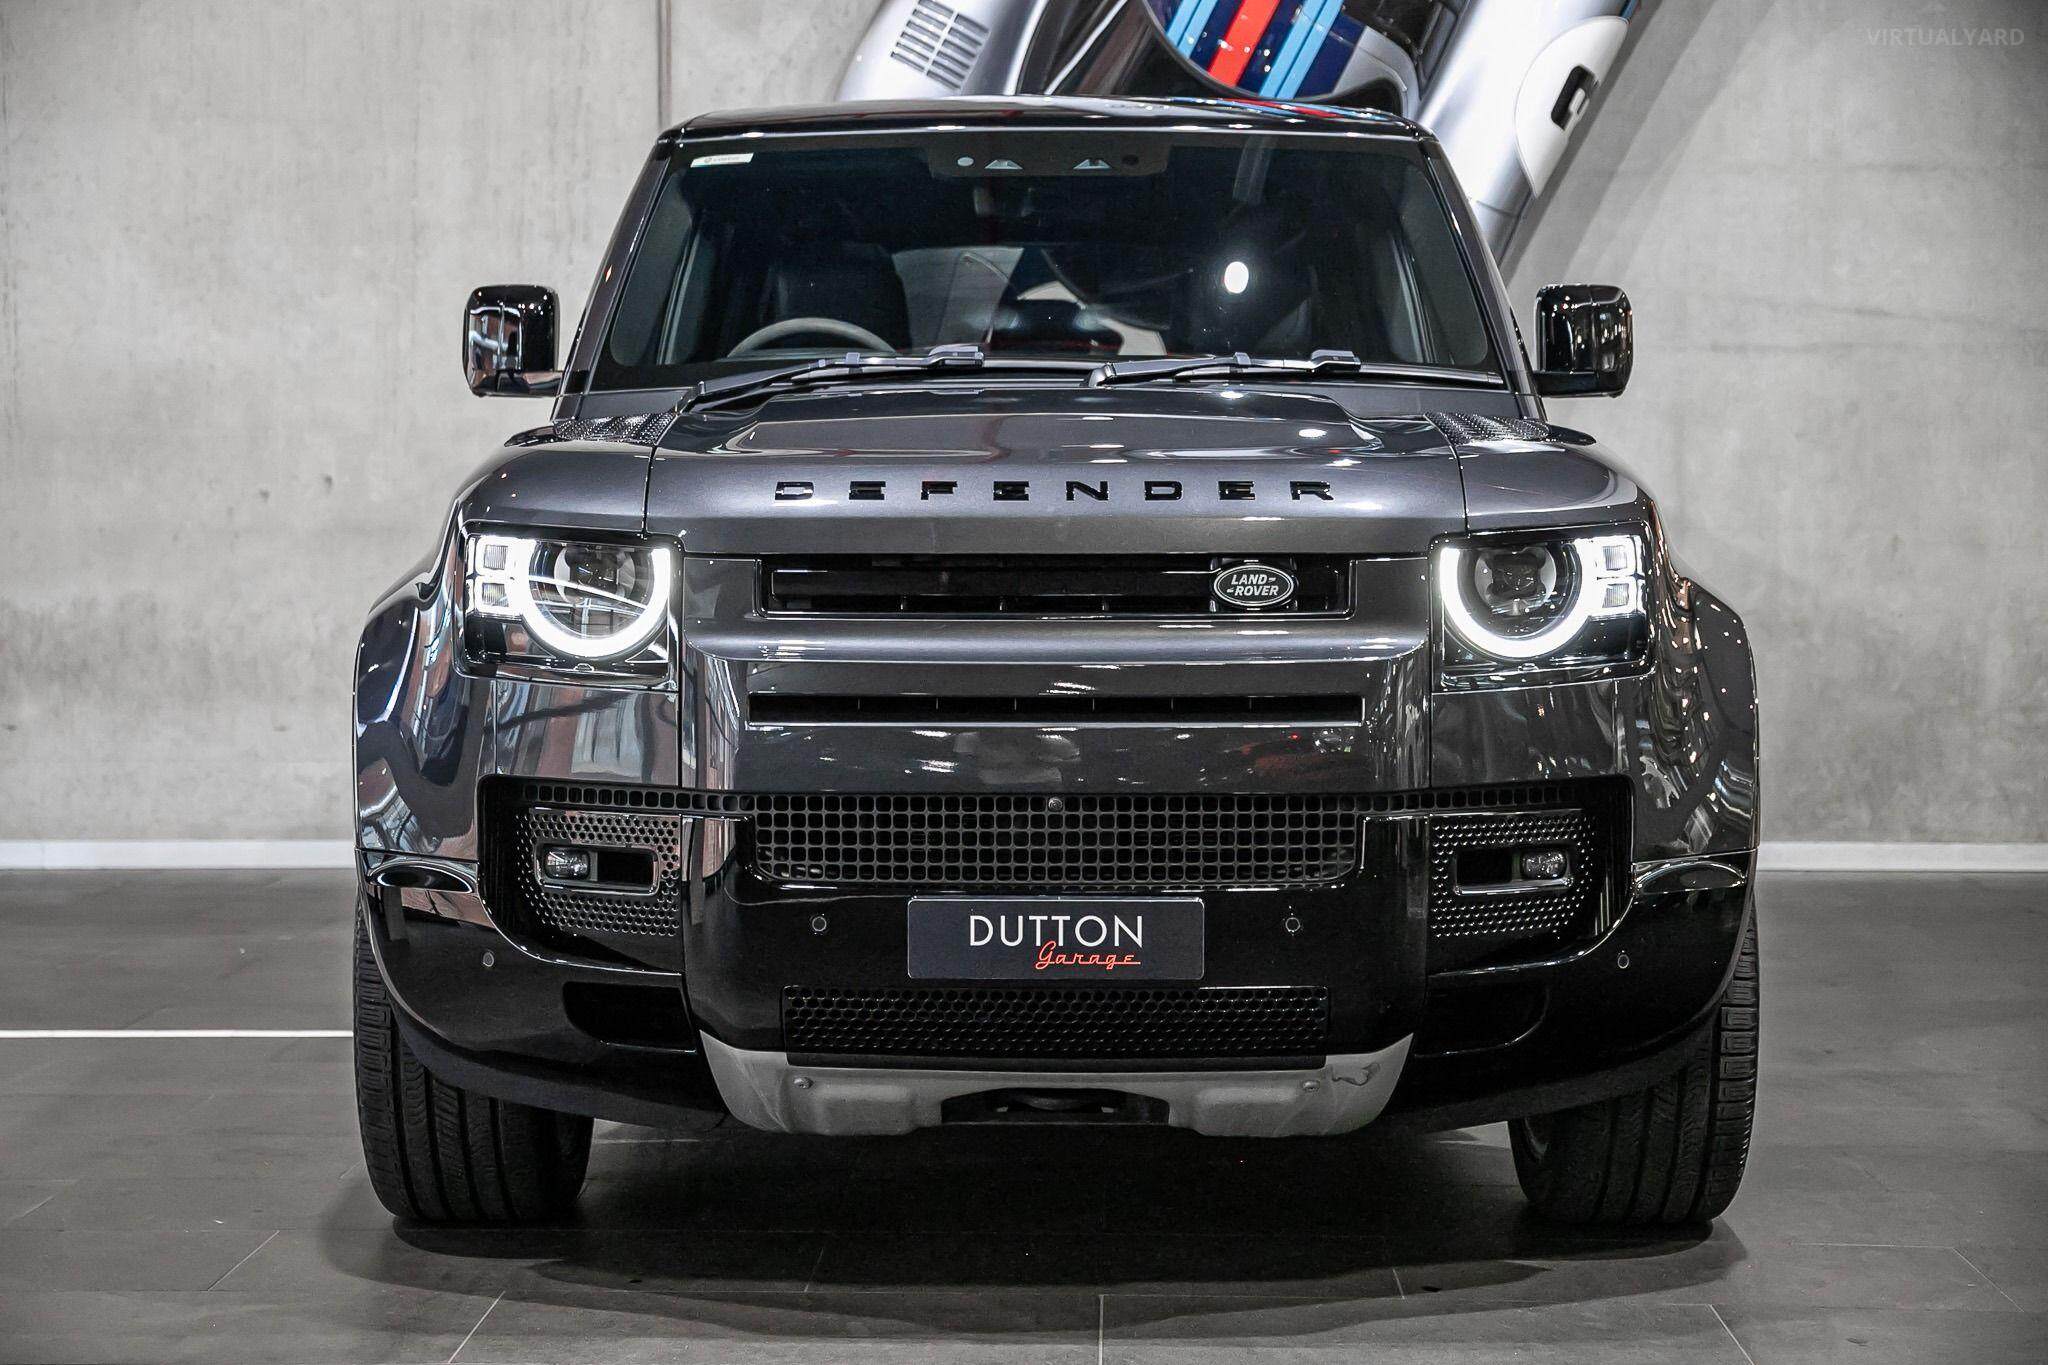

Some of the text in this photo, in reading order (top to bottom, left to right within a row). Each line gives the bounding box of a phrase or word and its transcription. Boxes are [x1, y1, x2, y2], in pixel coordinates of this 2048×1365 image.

[775, 480, 1334, 501] DEFENDER
[969, 914, 1143, 948] DUTTON
[1035, 940, 1141, 970] Garage
